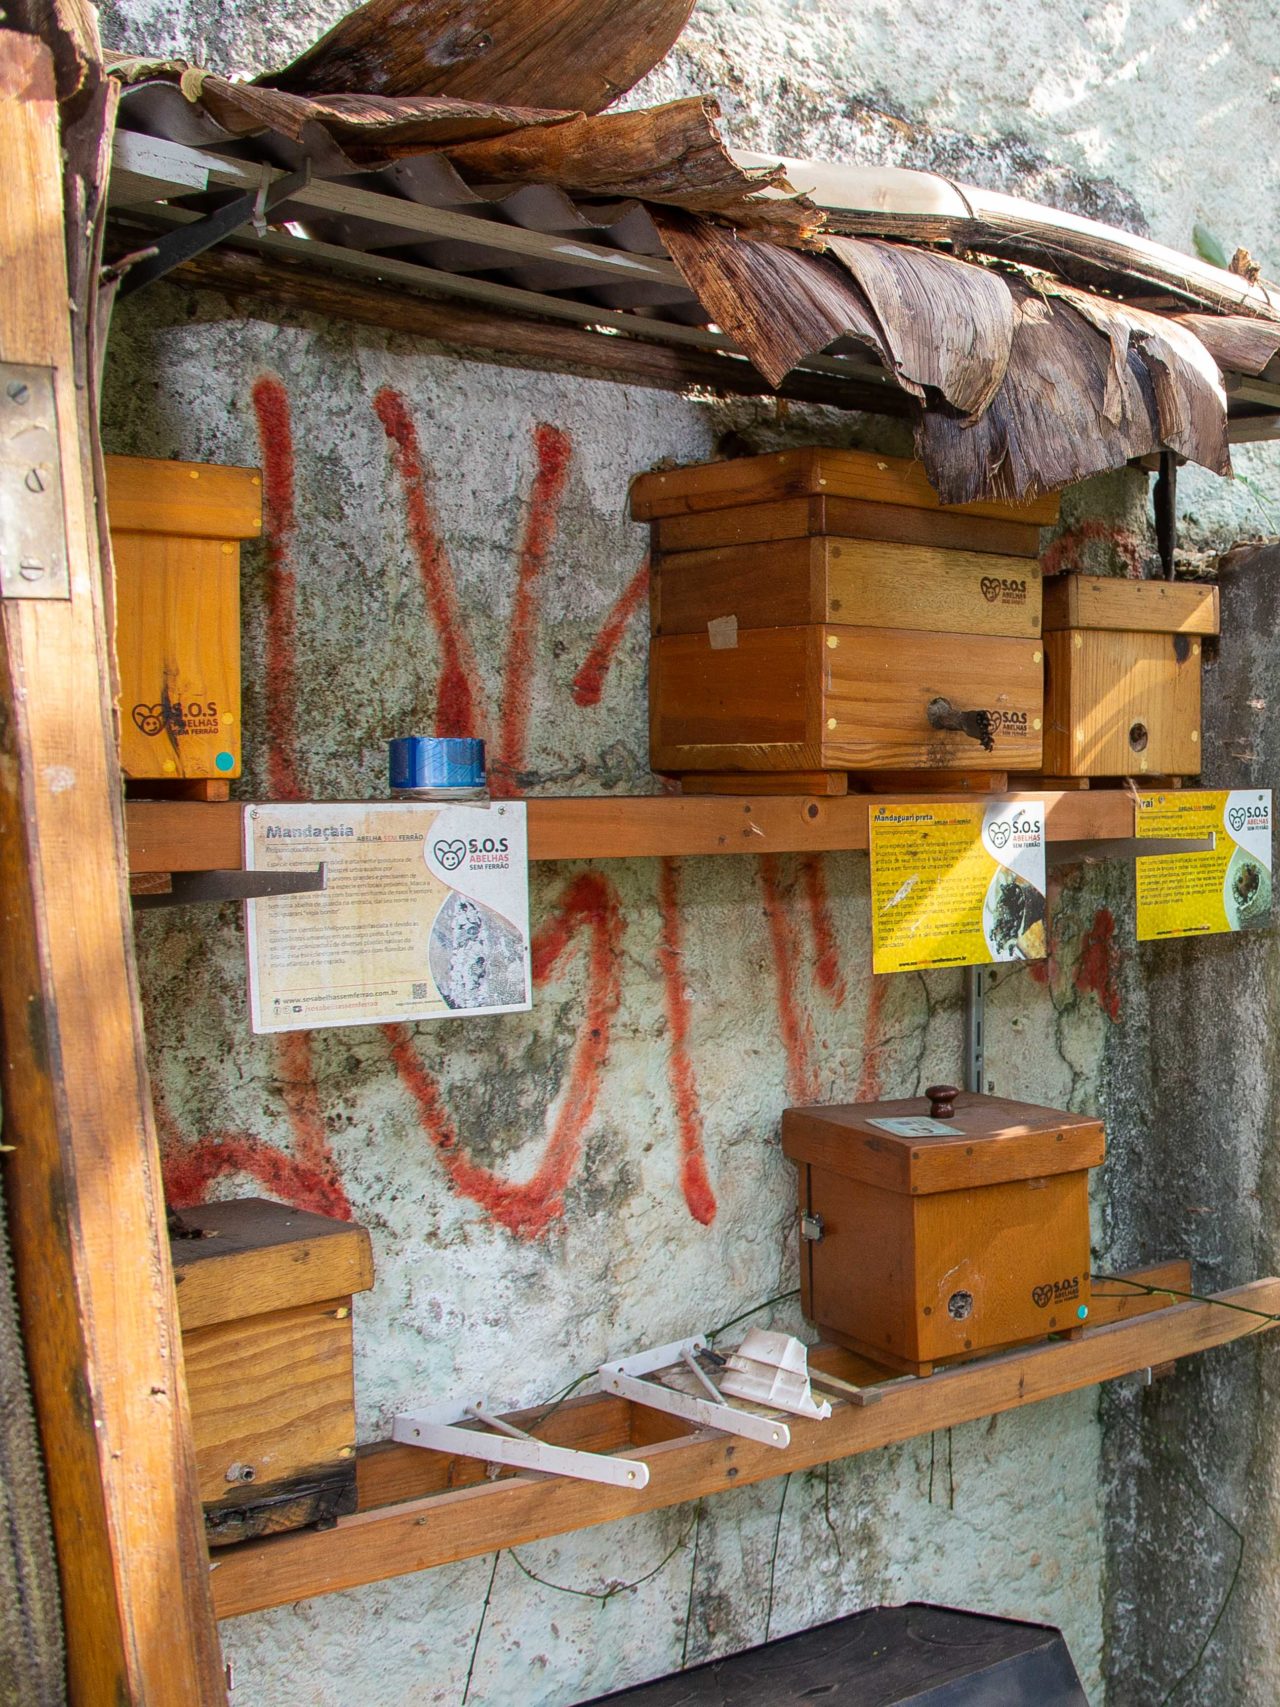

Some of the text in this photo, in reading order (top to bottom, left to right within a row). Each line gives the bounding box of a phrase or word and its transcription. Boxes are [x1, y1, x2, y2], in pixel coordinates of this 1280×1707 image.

[1002, 579, 1026, 592] S.O.S
[1003, 712, 1027, 724] S.O.S
[171, 719, 219, 729] ELHAS
[191, 727, 219, 735] FERRÃO
[875, 812, 914, 823] Mandaguari
[1247, 806, 1268, 818] S.O.S
[1012, 821, 1040, 833] S.O.S
[399, 832, 423, 841] FERRÃO
[1013, 834, 1040, 842] ABELHAS
[469, 838, 509, 853] S.O.S
[469, 854, 509, 863] ABELHAS
